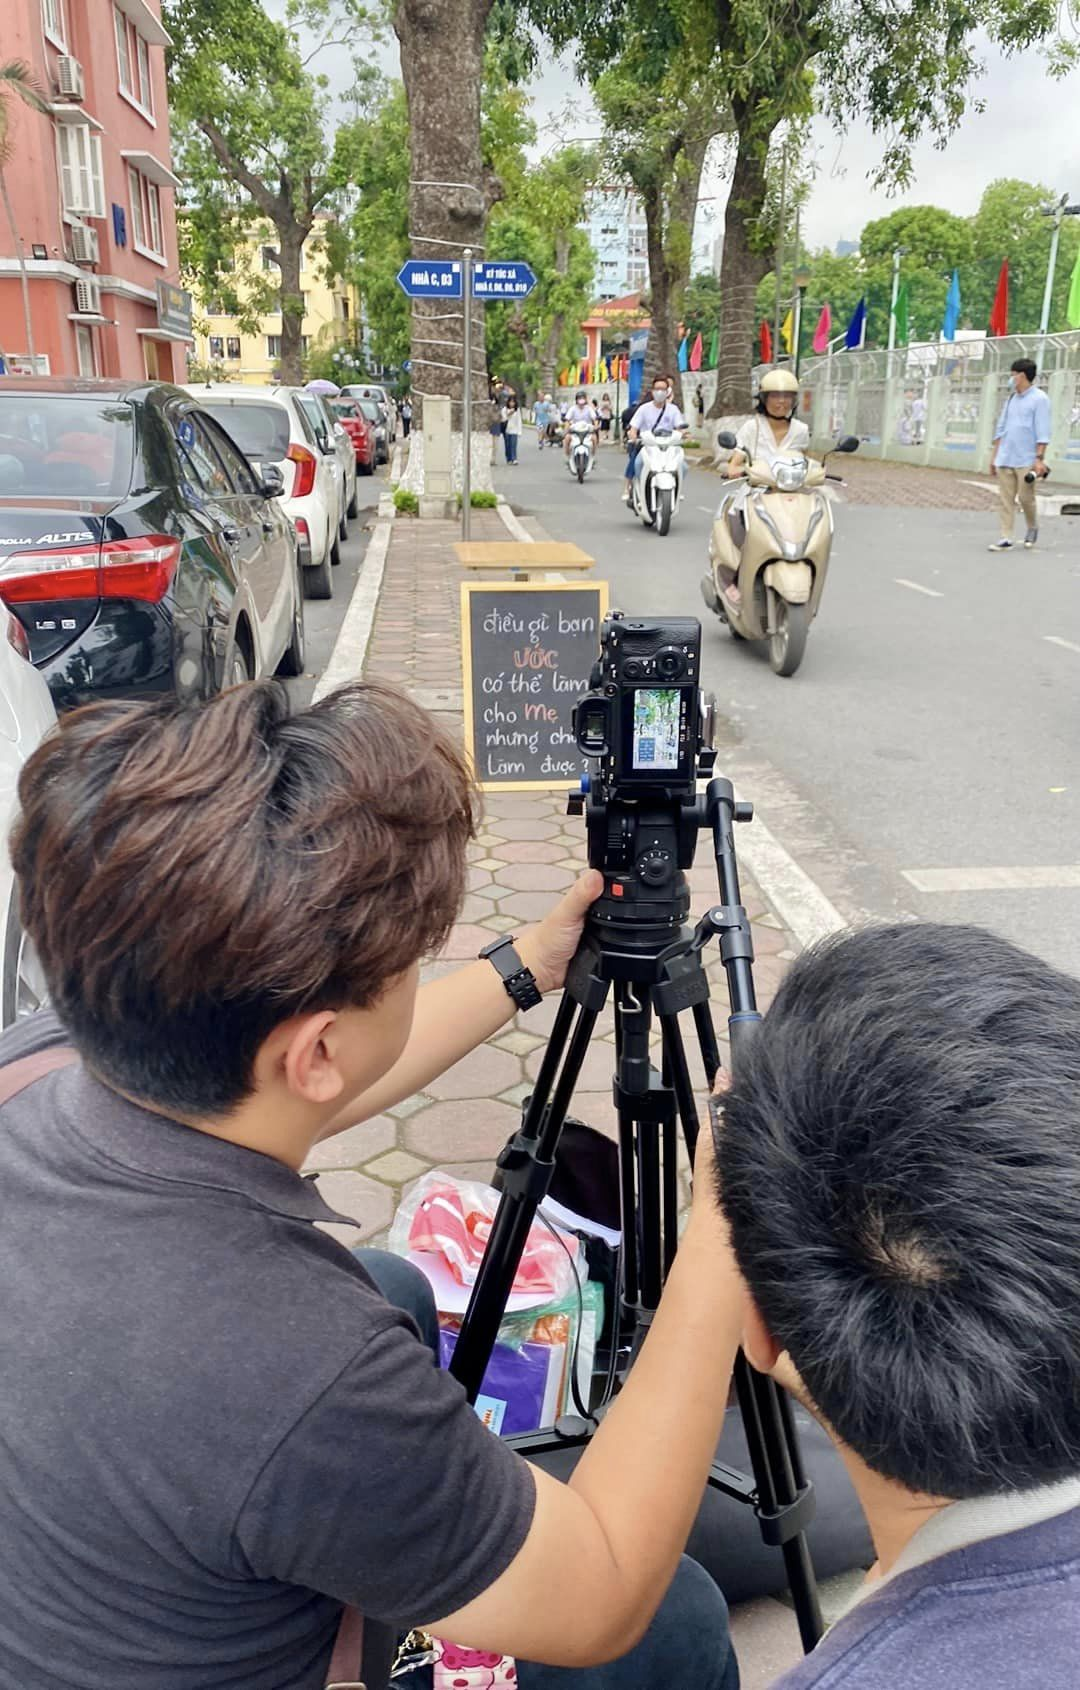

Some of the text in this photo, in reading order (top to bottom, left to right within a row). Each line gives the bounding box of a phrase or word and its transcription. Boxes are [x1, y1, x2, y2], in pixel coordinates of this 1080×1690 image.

[411, 269, 430, 286] NHÀ
[35, 531, 94, 545] ALTIS
[61, 619, 76, 630] G
[483, 607, 595, 644] điều gì bạn
[482, 671, 589, 694] có thể làm
[483, 701, 518, 723] cho
[540, 754, 577, 777] được
[581, 758, 590, 772] ?
